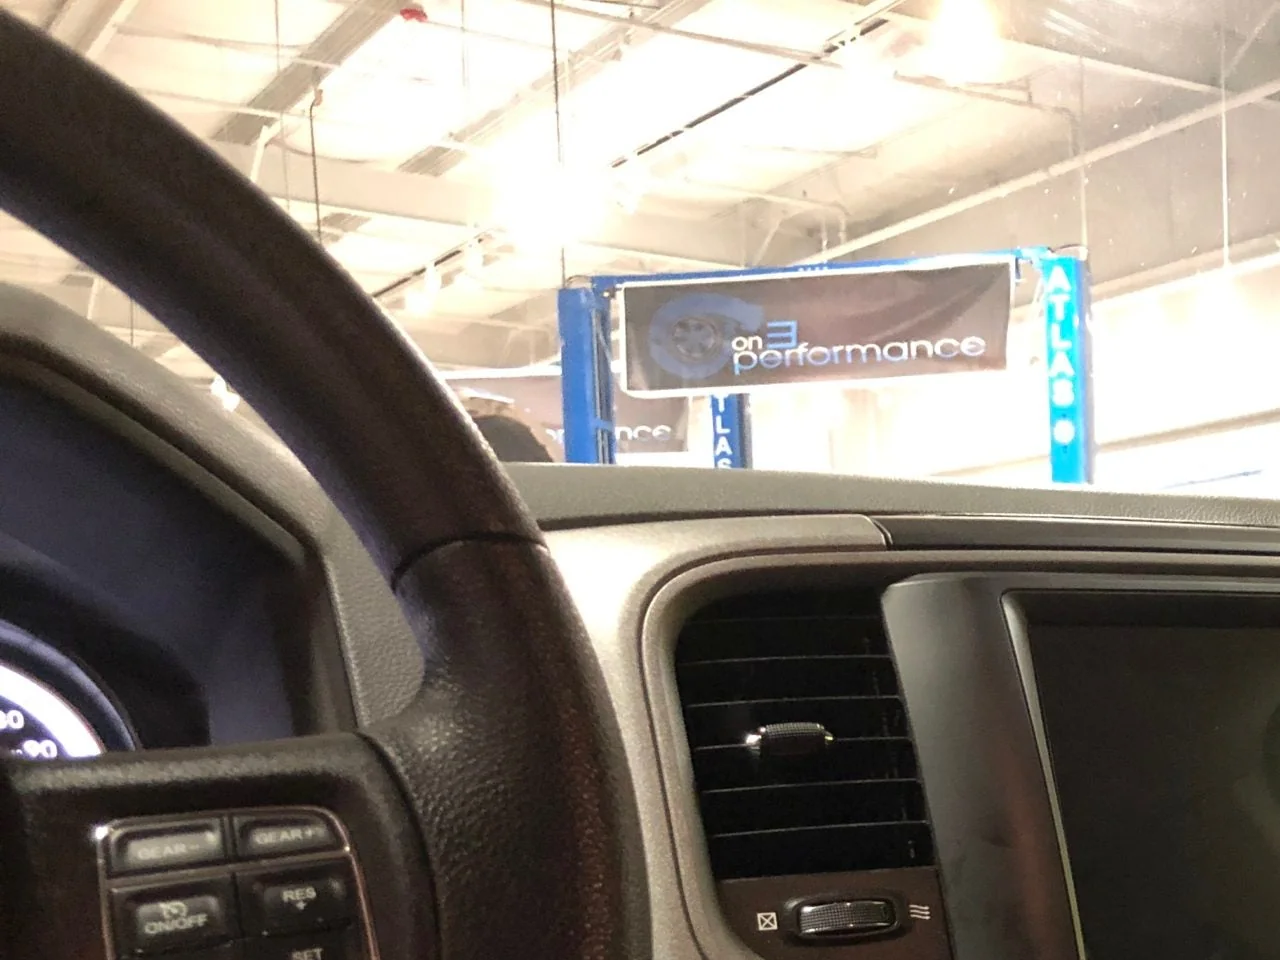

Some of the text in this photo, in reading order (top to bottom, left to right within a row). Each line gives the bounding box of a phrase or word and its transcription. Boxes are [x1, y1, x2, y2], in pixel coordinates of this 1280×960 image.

[731, 336, 762, 351] on
[732, 335, 987, 375] performance
[1047, 265, 1075, 408] ATLAS
[714, 392, 733, 469] TLAS
[282, 886, 316, 903] RES
